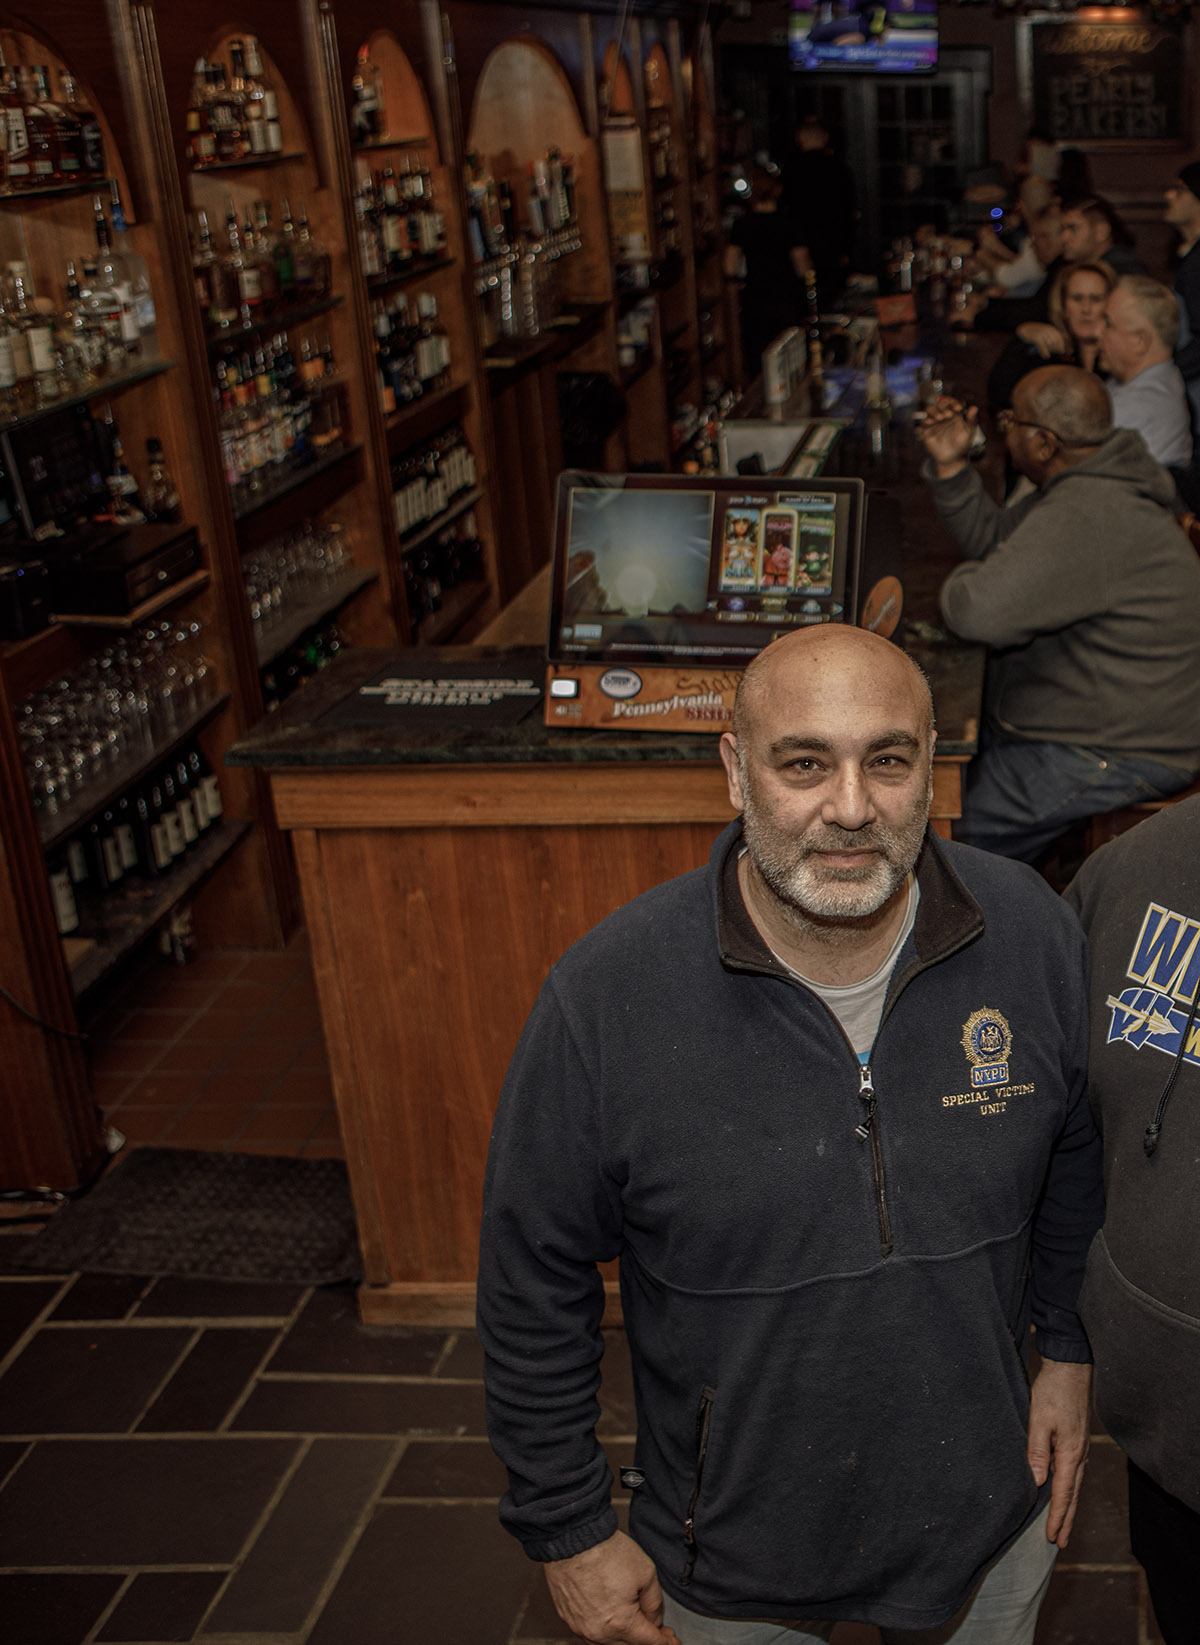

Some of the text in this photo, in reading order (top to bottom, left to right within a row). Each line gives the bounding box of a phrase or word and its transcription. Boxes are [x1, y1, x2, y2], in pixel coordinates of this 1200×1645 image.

[612, 691, 722, 718] Pennsylvania
[975, 1066, 1006, 1082] NYPD
[942, 1082, 1035, 1107] SPECIAL VICTIMS
[980, 1101, 1007, 1115] UNIT
